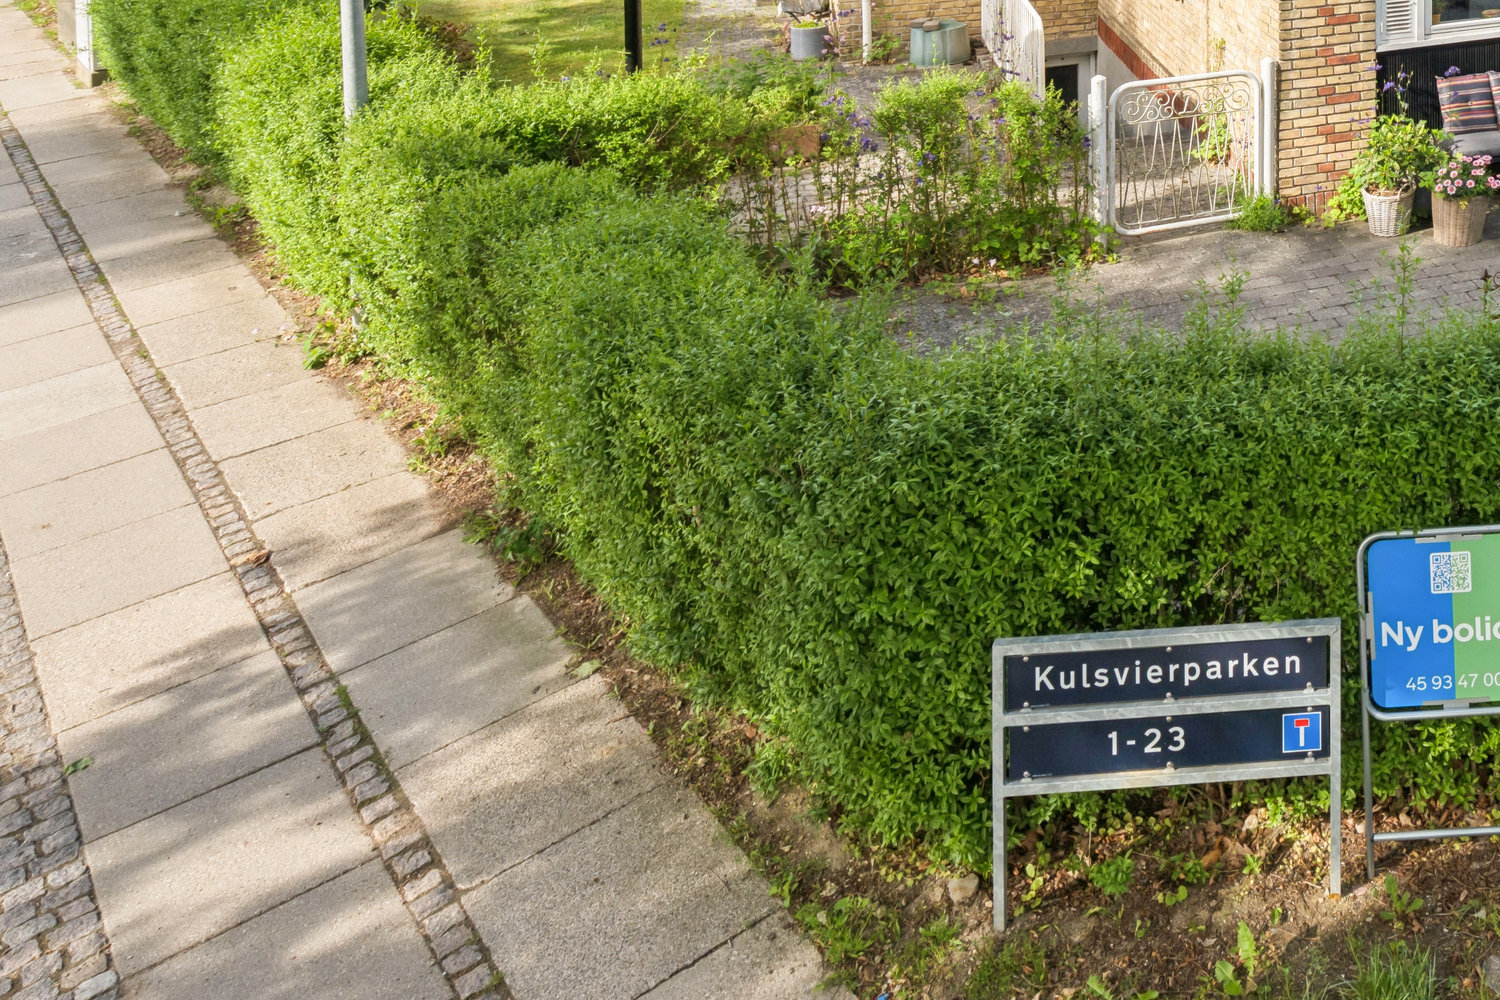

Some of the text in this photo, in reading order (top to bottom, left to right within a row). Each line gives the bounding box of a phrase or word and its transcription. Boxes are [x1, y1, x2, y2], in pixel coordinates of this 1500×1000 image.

[1381, 621, 1424, 652] Ny
[1035, 652, 1301, 691] Kulsvierparken
[1406, 676, 1427, 691] 45
[1431, 675, 1453, 690] 93
[1457, 673, 1479, 688] 47
[1108, 727, 1186, 756] 1-23
